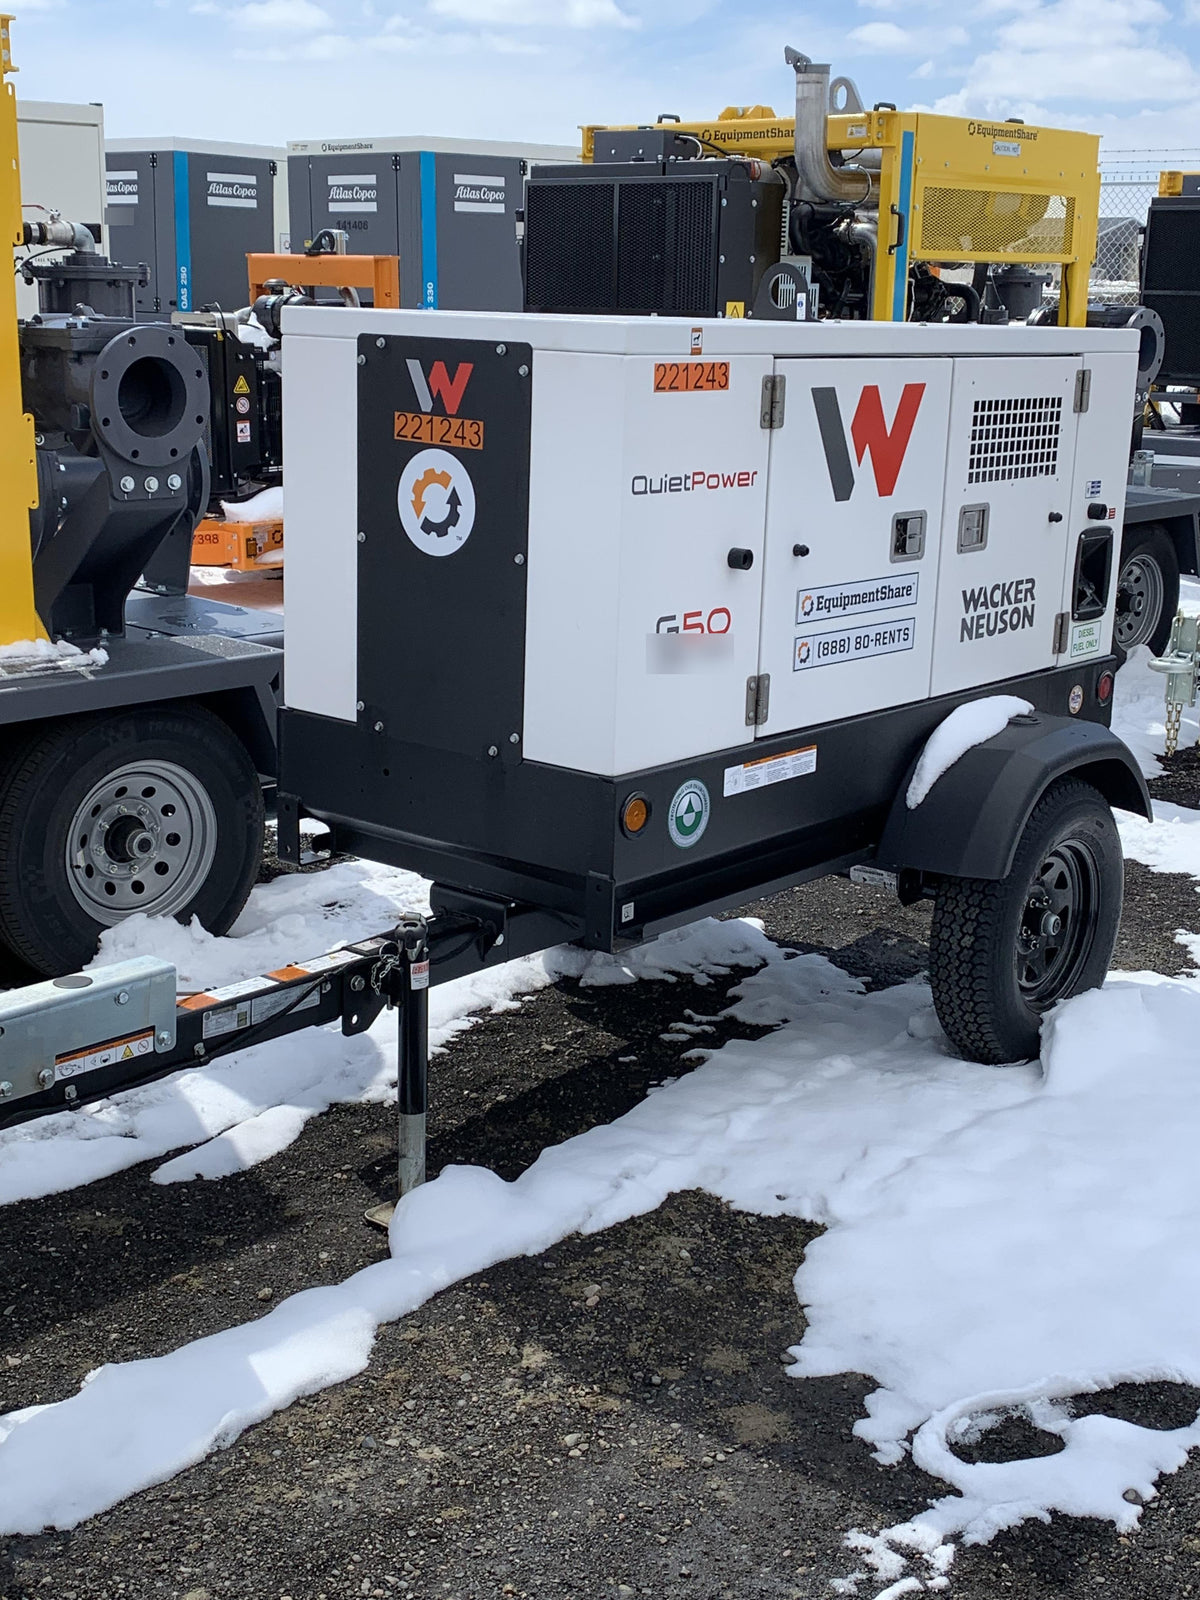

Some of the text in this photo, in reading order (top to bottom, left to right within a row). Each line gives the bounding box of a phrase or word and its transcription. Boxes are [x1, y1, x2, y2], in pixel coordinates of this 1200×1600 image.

[713, 127, 795, 143] EquipmentShar
[976, 124, 1038, 141] EquipmentShare
[327, 142, 373, 152] EquipmentShare
[336, 220, 369, 231] 141406
[180, 266, 188, 286] 250
[426, 281, 434, 304] 330
[655, 362, 729, 391] 221243
[395, 412, 482, 447] 221243
[631, 470, 758, 496] QuietPower
[193, 533, 219, 545] 398
[815, 583, 913, 613] EquipmentShare
[961, 577, 1036, 614] WACKER
[655, 606, 732, 635] G50
[959, 603, 1036, 643] NEUSON
[817, 626, 910, 659] (888) 80-RENTS
[1078, 626, 1095, 640] DIESEL
[1072, 638, 1098, 653] FUEL ONLY
